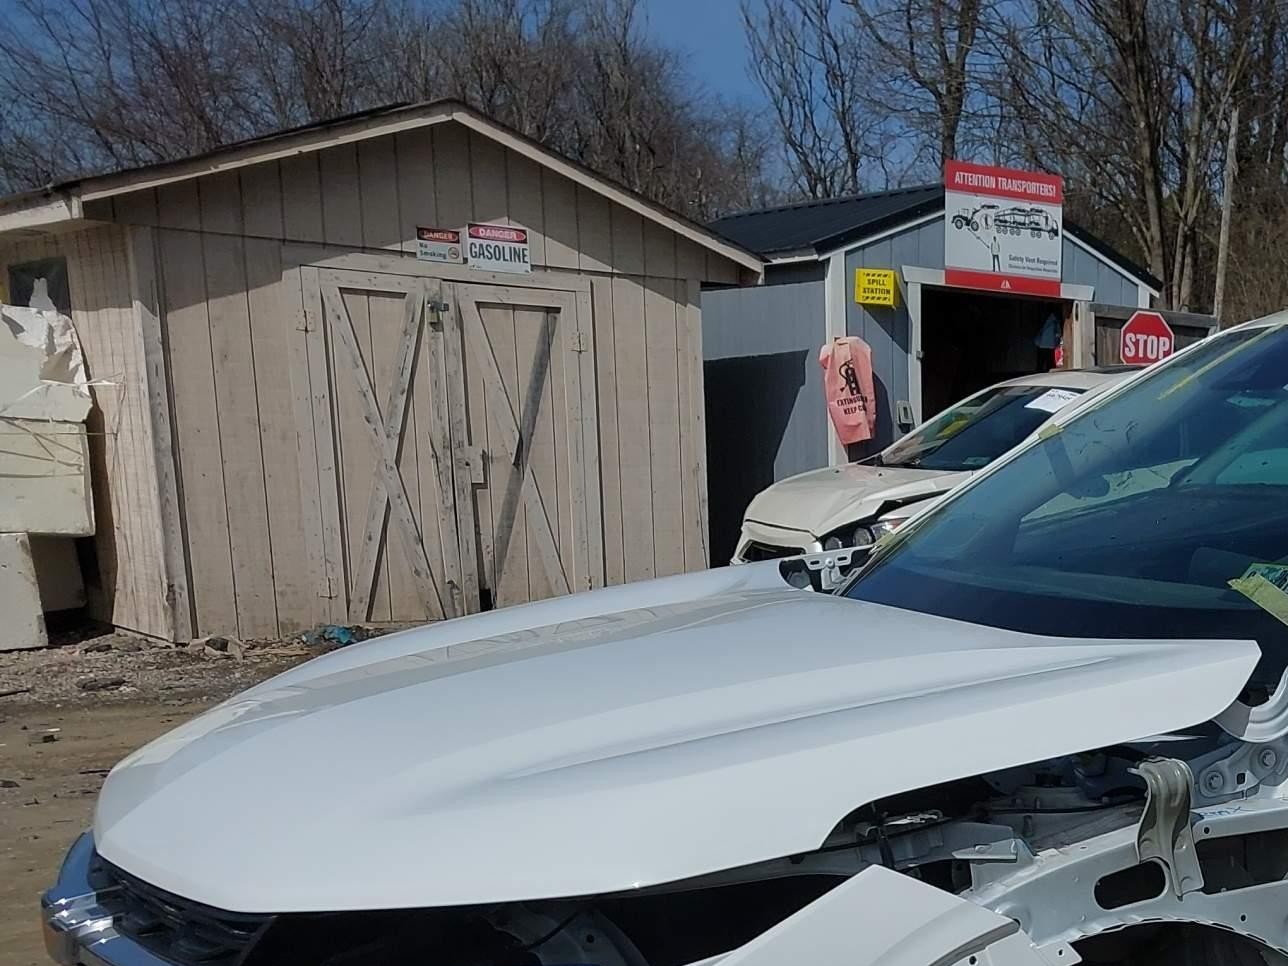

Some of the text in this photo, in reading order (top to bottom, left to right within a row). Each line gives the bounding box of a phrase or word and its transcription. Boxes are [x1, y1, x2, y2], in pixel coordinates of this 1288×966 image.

[954, 171, 1057, 198] ATTENTION TRANSPORTERS!
[479, 228, 517, 241] DANGER
[469, 242, 529, 264] GASOLINE
[1125, 332, 1170, 360] STOP
